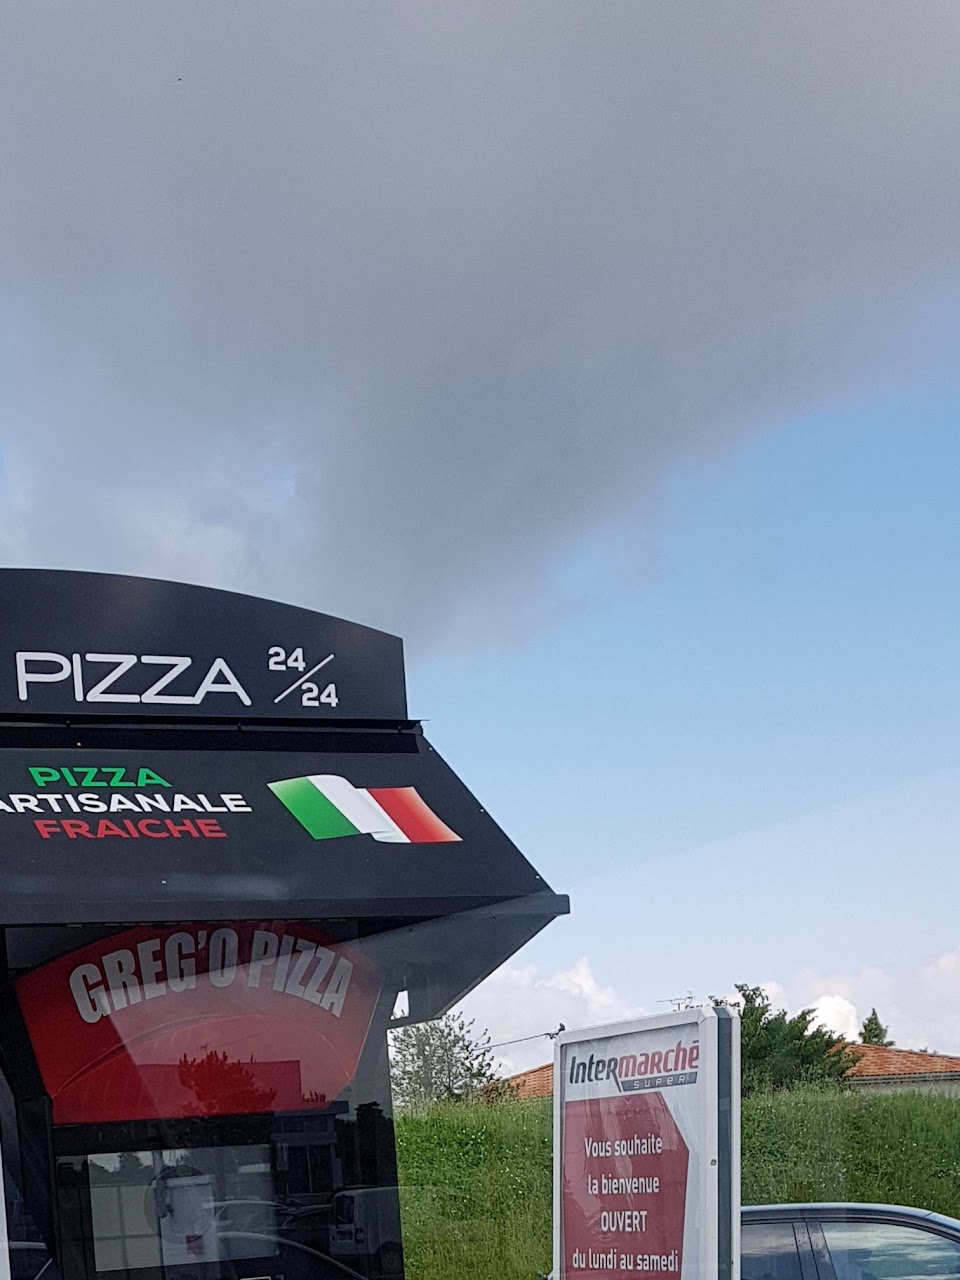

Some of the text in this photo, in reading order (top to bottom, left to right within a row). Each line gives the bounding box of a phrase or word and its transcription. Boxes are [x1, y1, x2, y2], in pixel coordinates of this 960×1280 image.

[16, 651, 251, 706] PIZZA
[28, 766, 173, 788] PIZZA
[33, 818, 227, 840] FRAICHE
[68, 928, 354, 1024] GREG'O PIZZA
[570, 1040, 700, 1092] Intermarché
[633, 1075, 686, 1089] SUPER
[584, 1132, 663, 1158] Vous souhaite
[587, 1174, 660, 1195] la bienvenue
[600, 1210, 648, 1233] OUVERT
[572, 1251, 679, 1273] du lundi au samedi
